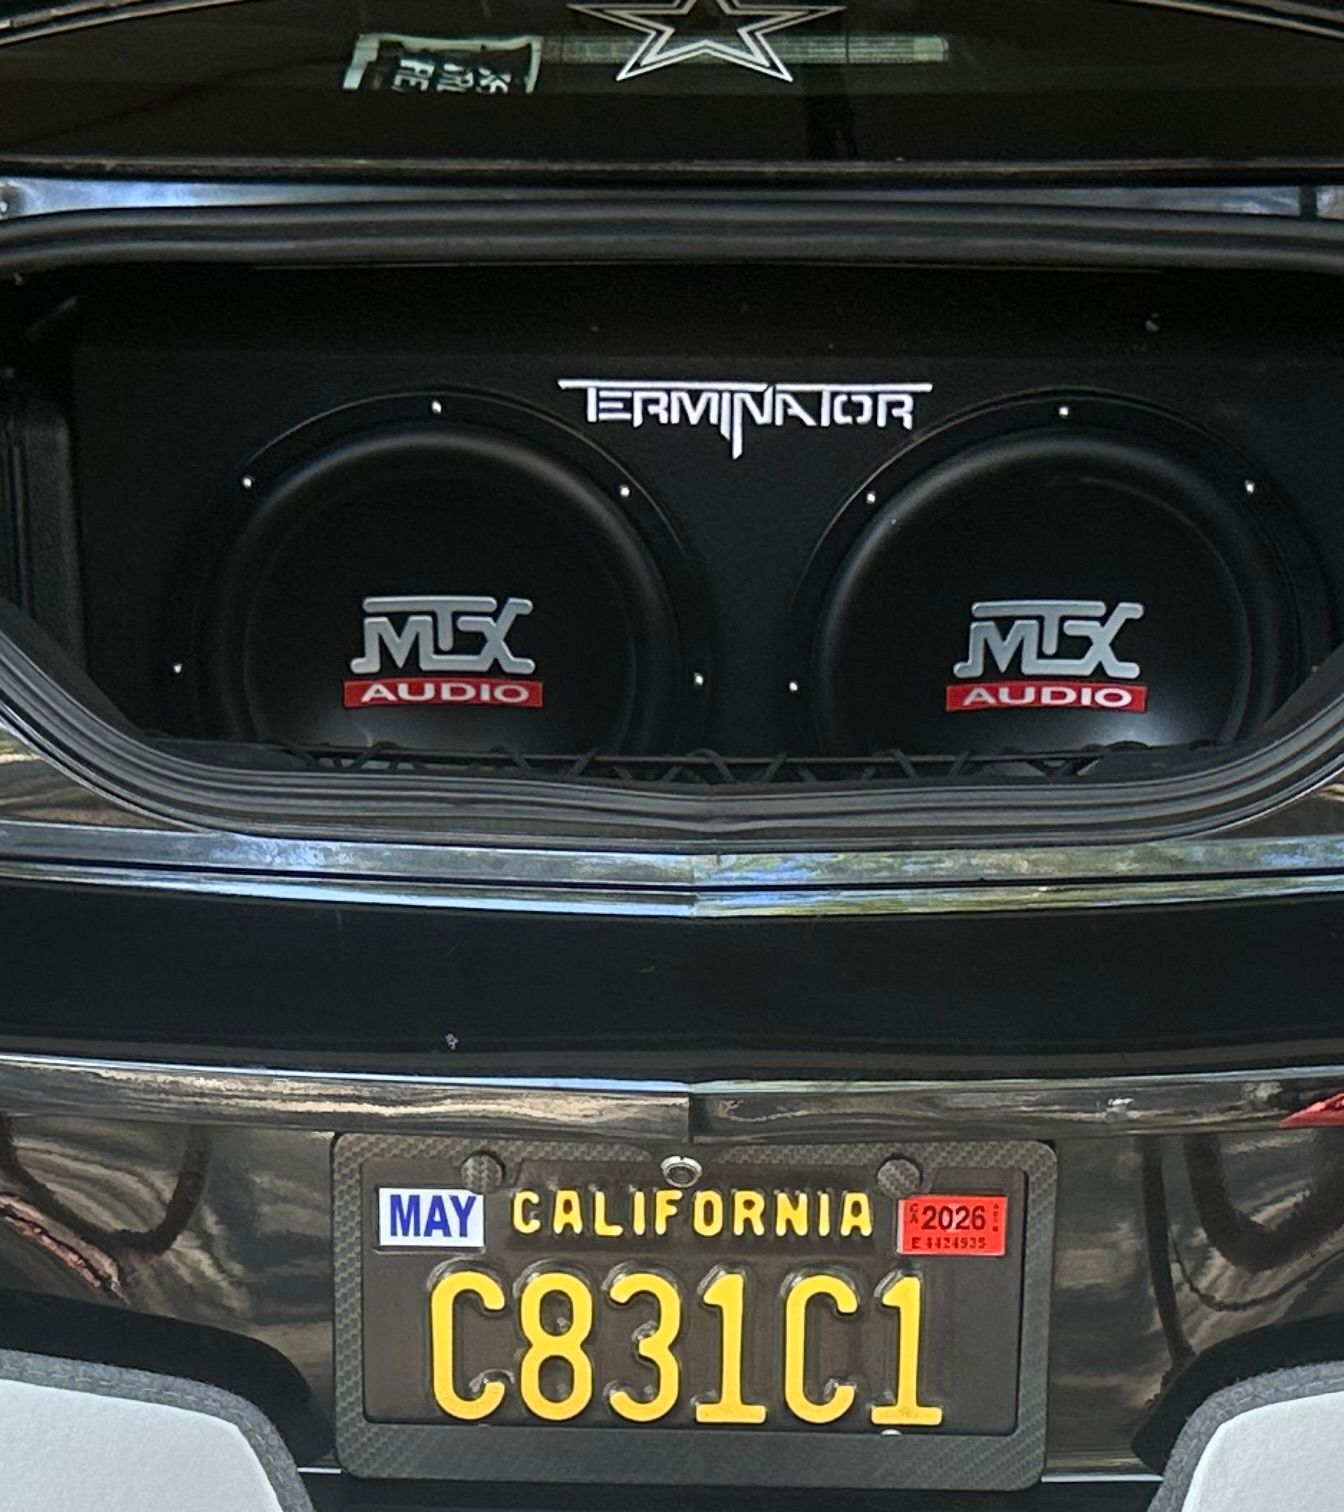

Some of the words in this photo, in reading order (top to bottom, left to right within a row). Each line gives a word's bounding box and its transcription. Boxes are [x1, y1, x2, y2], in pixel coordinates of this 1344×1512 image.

[558, 379, 933, 460] TERMINATOR
[350, 596, 535, 674] MTX
[953, 600, 1144, 679] MTX
[361, 682, 530, 704] AUDIO
[962, 686, 1133, 708] AUDIO
[390, 1194, 476, 1238] MAY
[511, 1189, 873, 1238] CALIFORNIA
[920, 1205, 987, 1231] 2026
[431, 1271, 944, 1425] C831C1
